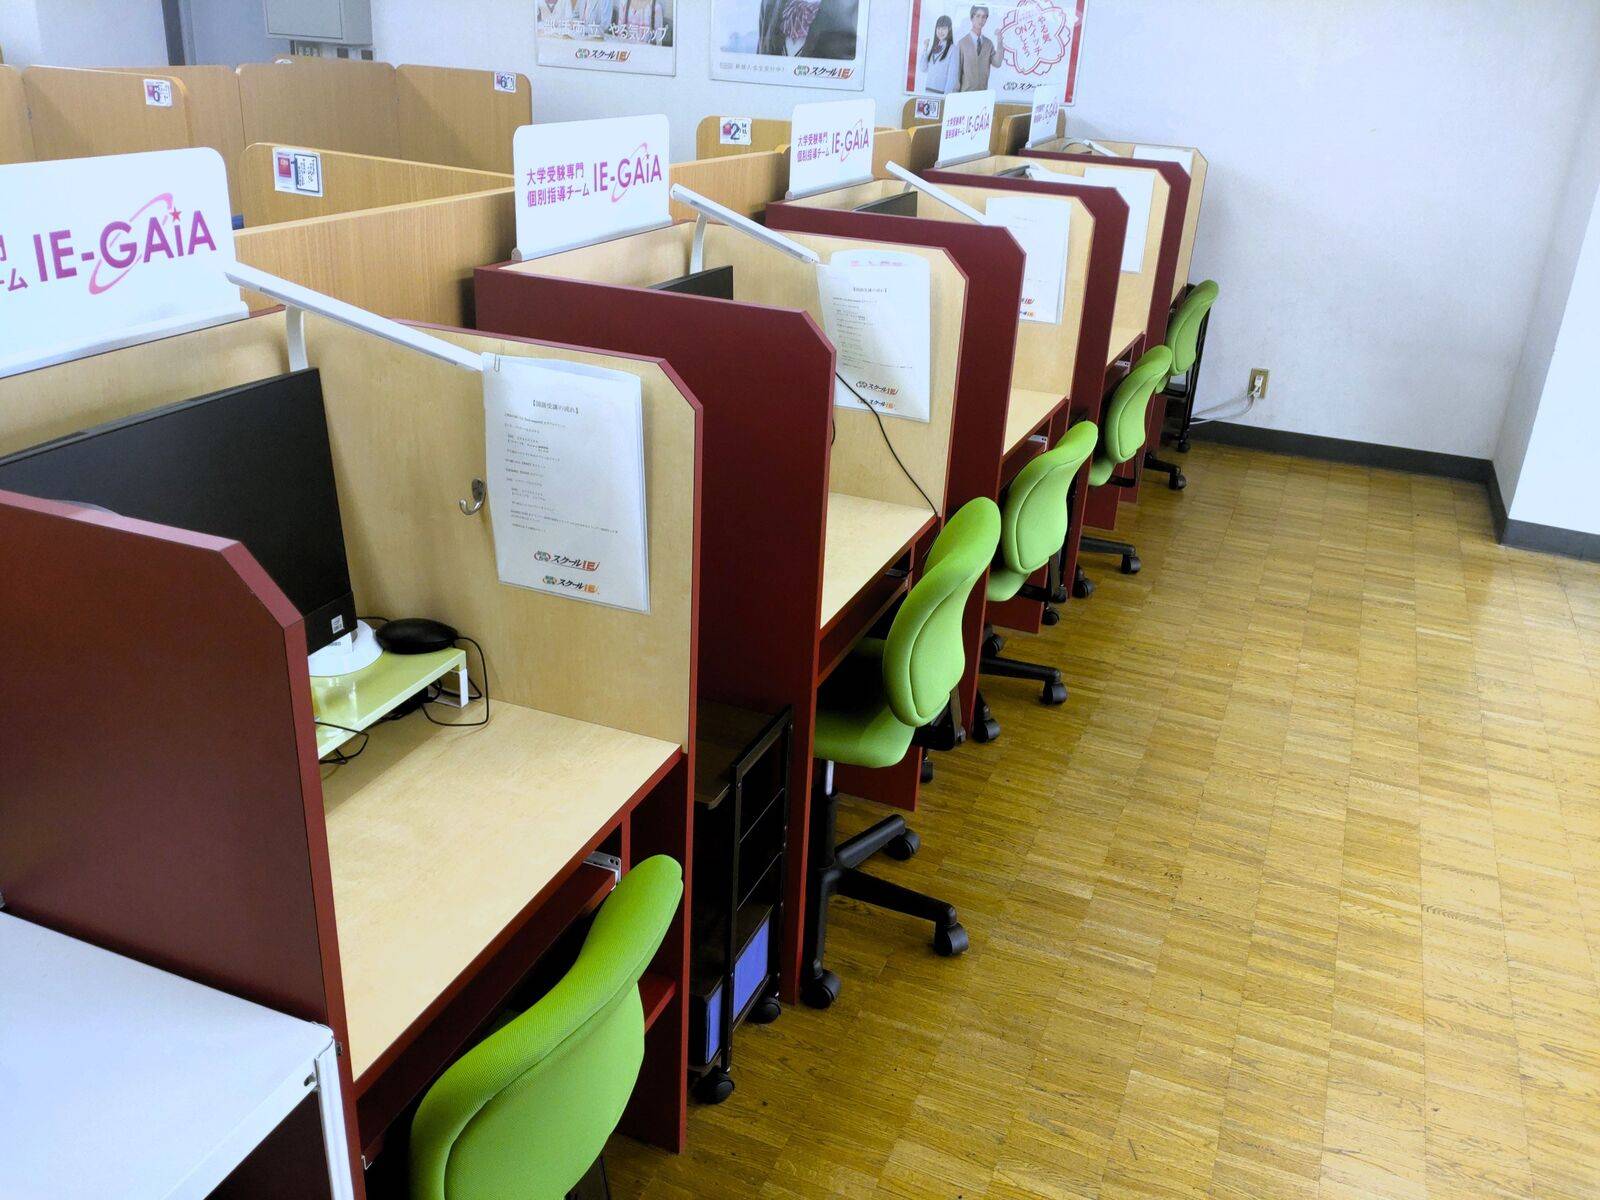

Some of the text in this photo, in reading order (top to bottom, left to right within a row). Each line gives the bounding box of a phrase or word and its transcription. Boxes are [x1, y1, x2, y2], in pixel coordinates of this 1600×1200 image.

[731, 122, 741, 140] 2
[526, 162, 585, 186] 大学受験専門
[527, 183, 590, 208] 個別指導チーム
[0, 268, 28, 292] ム
